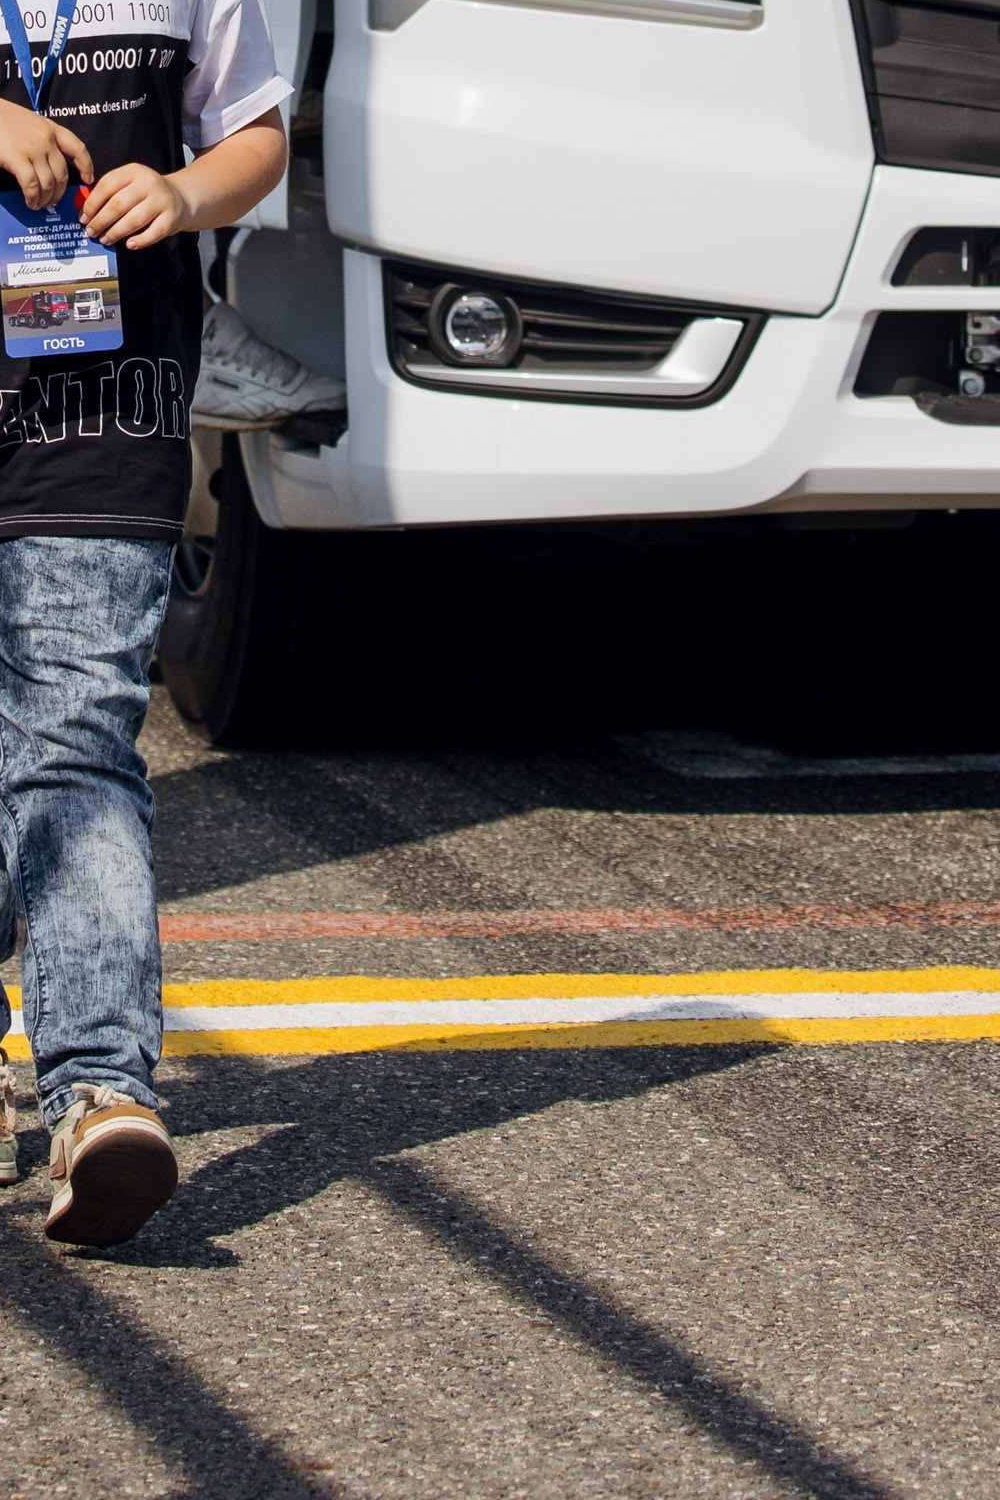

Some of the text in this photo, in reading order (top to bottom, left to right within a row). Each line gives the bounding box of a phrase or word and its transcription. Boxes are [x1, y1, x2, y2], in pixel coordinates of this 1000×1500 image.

[71, 2, 115, 25] 0001
[128, 2, 171, 24] 11001
[50, 15, 69, 58] KAMAZ
[92, 47, 144, 72] 00001
[49, 105, 77, 118] know
[78, 103, 101, 115] that
[102, 100, 121, 113] does
[122, 98, 129, 110] it
[27, 222, 81, 234] ТЕСТ-ДРАЙВ
[8, 230, 72, 244] АВТОМОБИЛЕЙ
[24, 240, 76, 251] ПОКОЛЕНИЯ
[43, 337, 85, 350] ГОСТЬ
